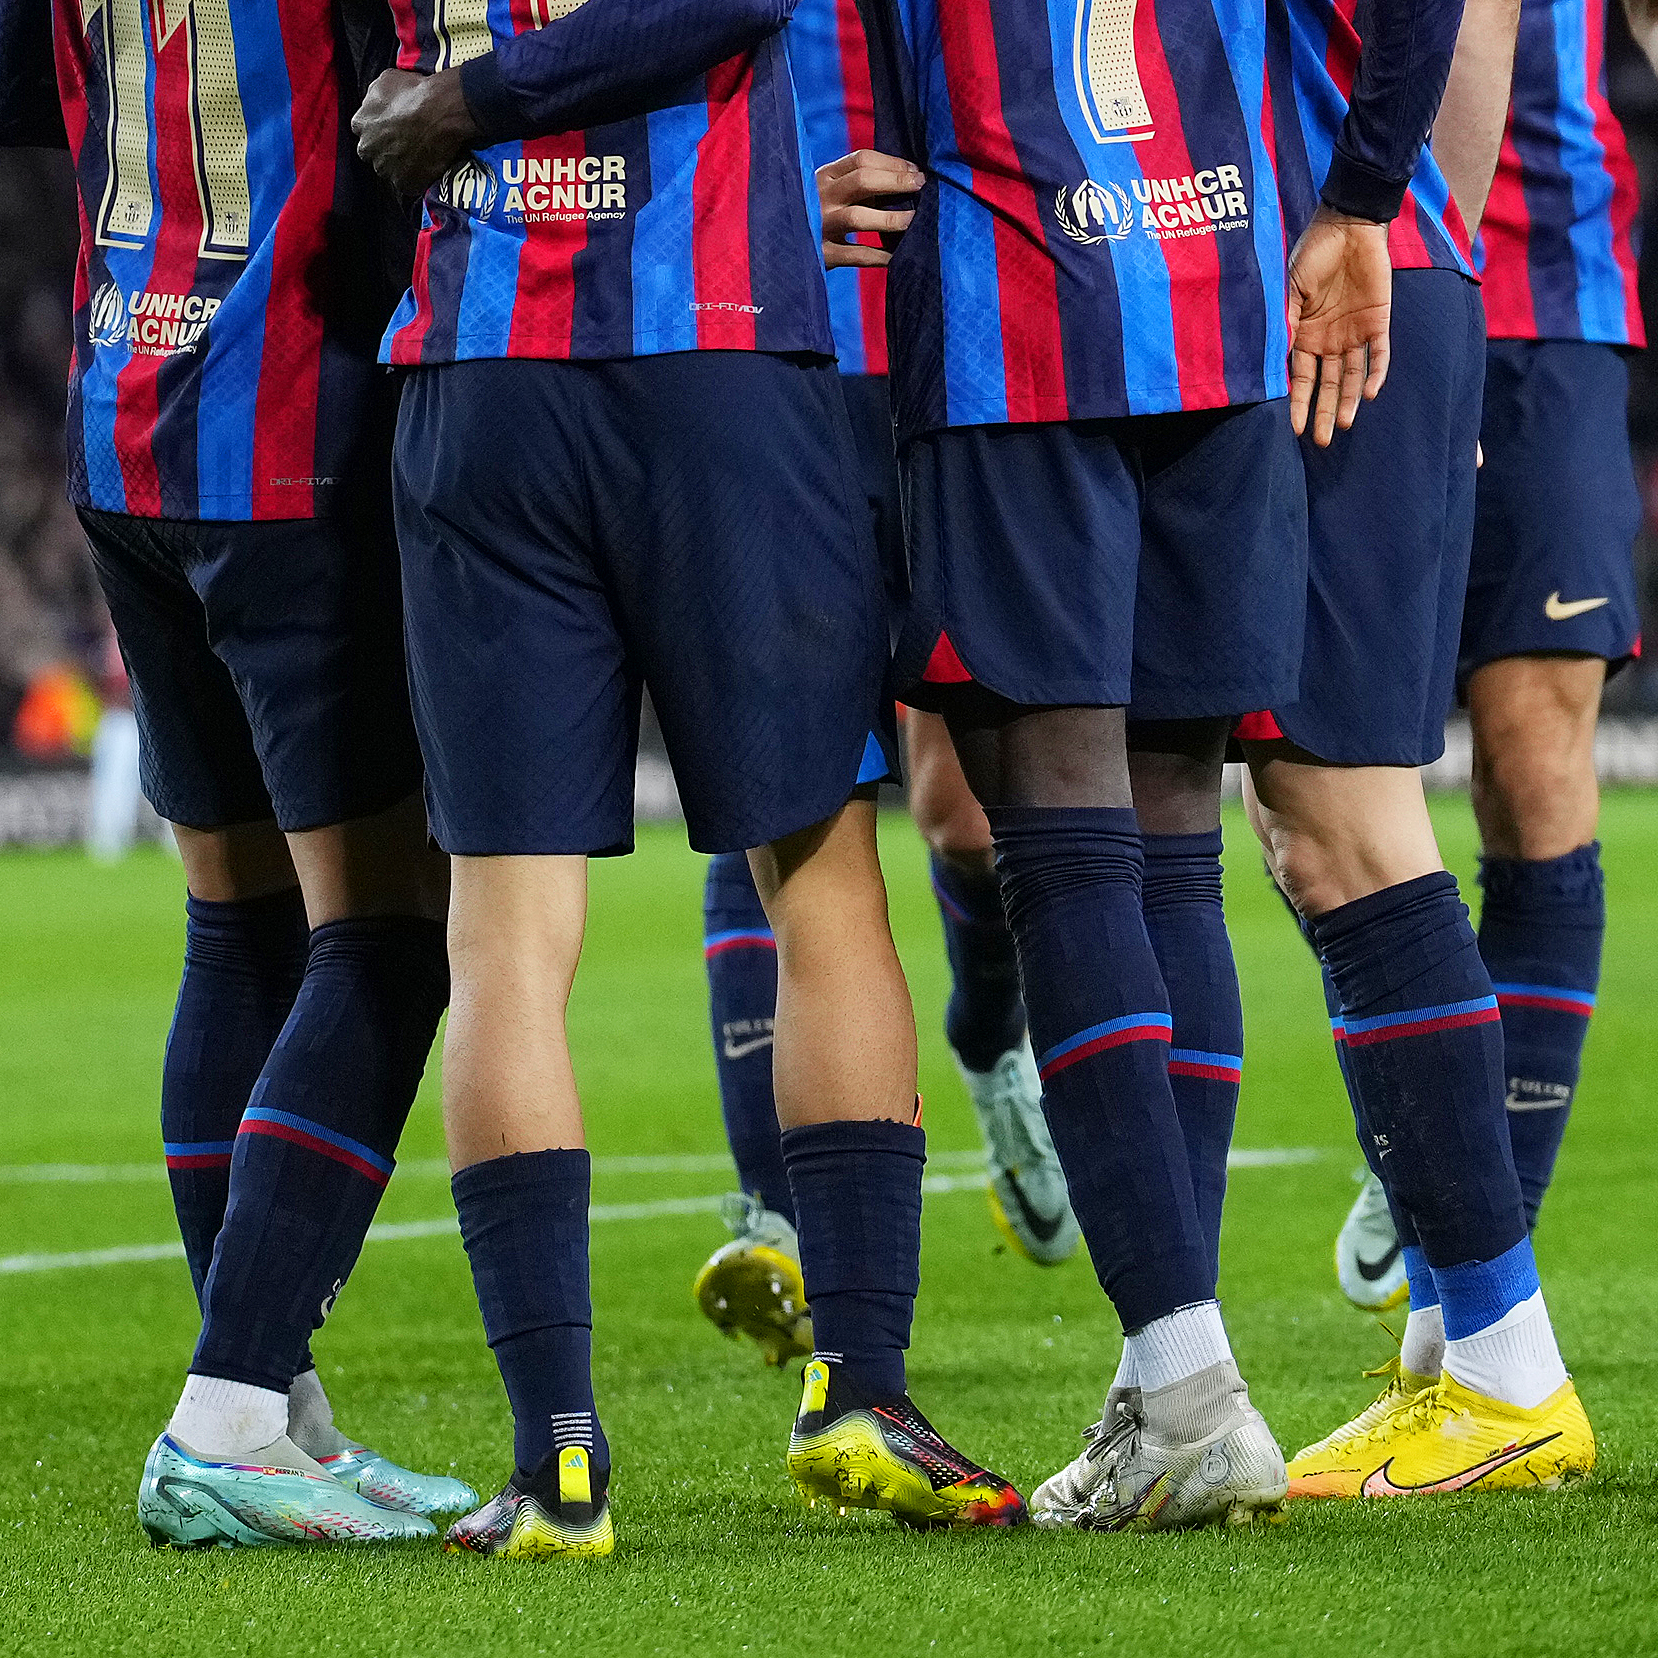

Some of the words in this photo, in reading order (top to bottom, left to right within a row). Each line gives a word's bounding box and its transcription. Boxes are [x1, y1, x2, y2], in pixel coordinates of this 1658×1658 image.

[502, 155, 626, 184] UNHCR
[1130, 164, 1244, 203] UNHCR
[502, 183, 627, 212] ACNUR
[1141, 191, 1248, 229] ACNUR
[505, 214, 524, 224] The
[525, 213, 541, 223] UN
[542, 212, 585, 223] Refugee
[586, 210, 626, 221] Agency
[1145, 230, 1161, 240] The
[1160, 228, 1177, 240] UN
[1177, 223, 1218, 239] Refugee
[1218, 219, 1249, 232] Agency
[127, 290, 223, 321] UNHCR
[138, 344, 150, 355] UN
